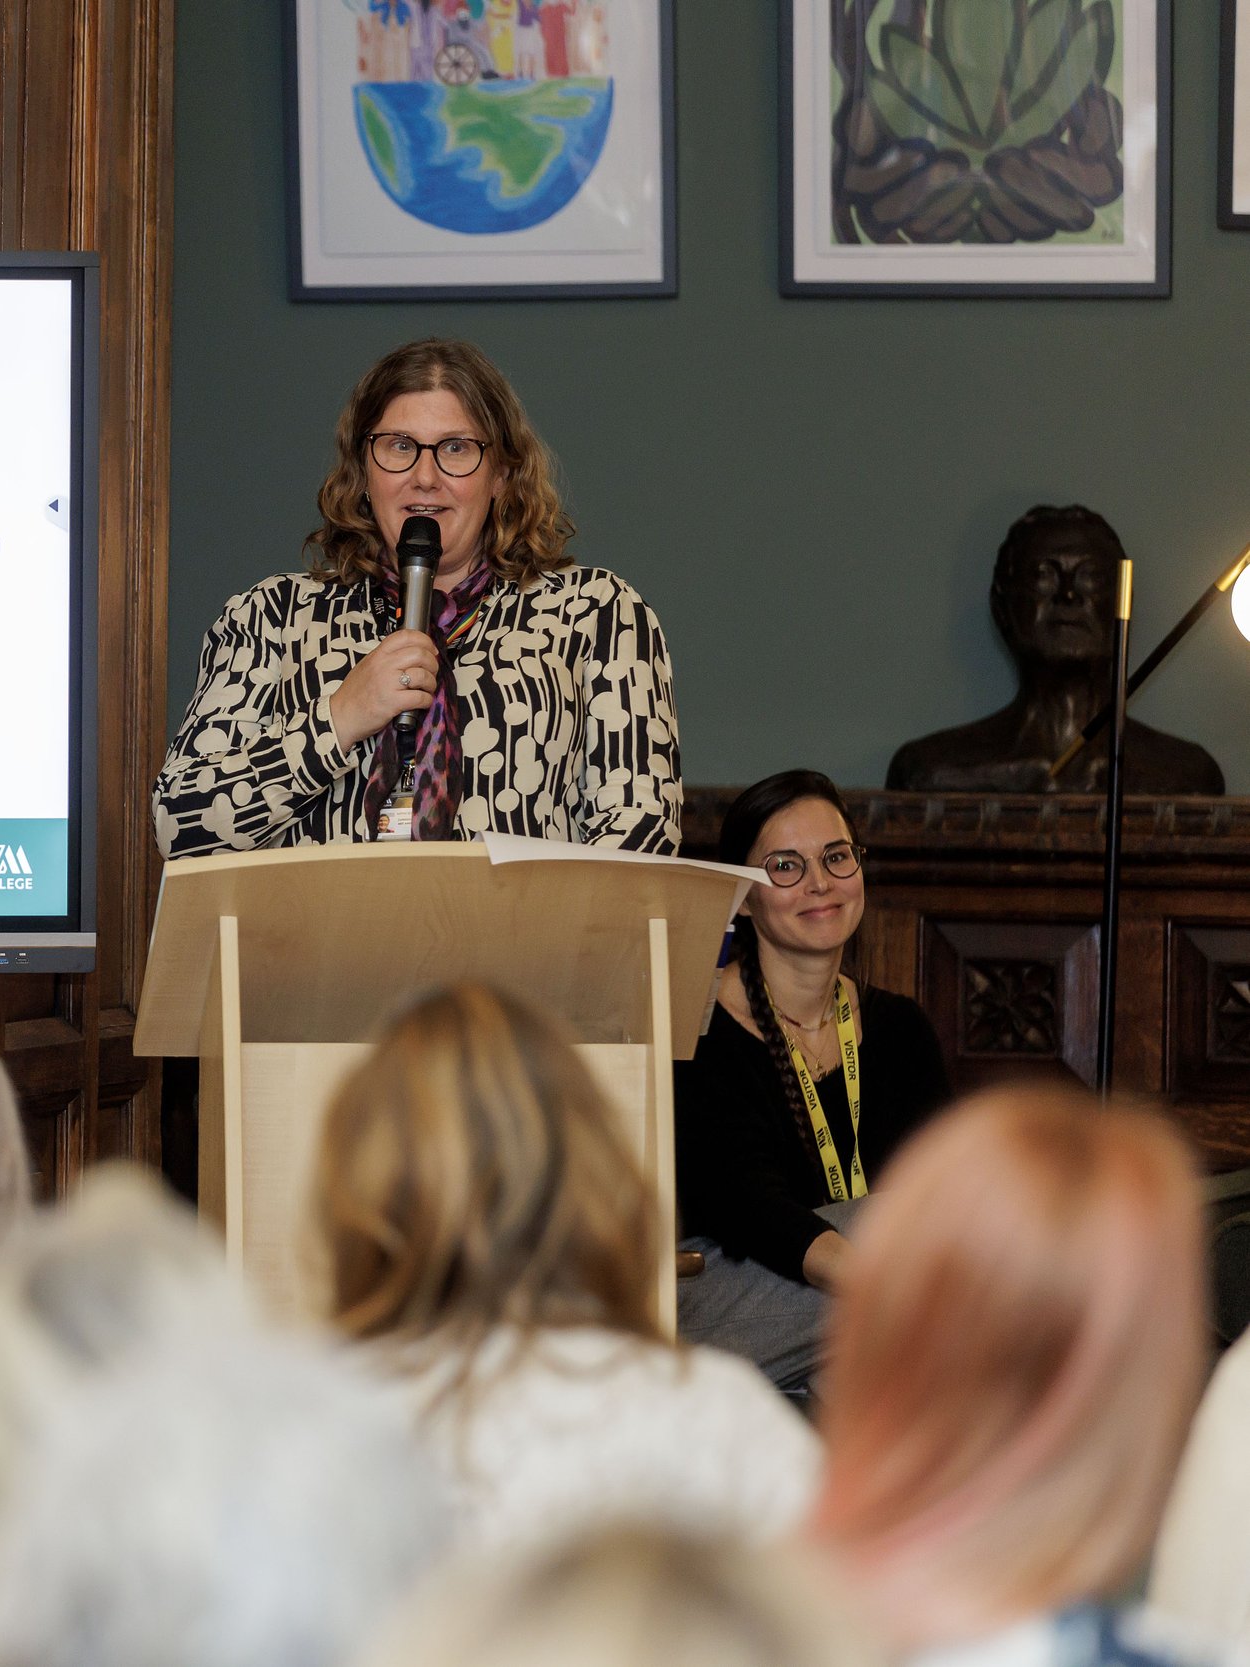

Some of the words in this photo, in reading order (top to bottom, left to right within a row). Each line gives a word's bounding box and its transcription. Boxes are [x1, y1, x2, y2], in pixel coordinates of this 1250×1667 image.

[844, 1039, 856, 1081] VISITOR
[800, 1069, 817, 1111] VISITOR
[828, 1164, 845, 1201] ISITOR
